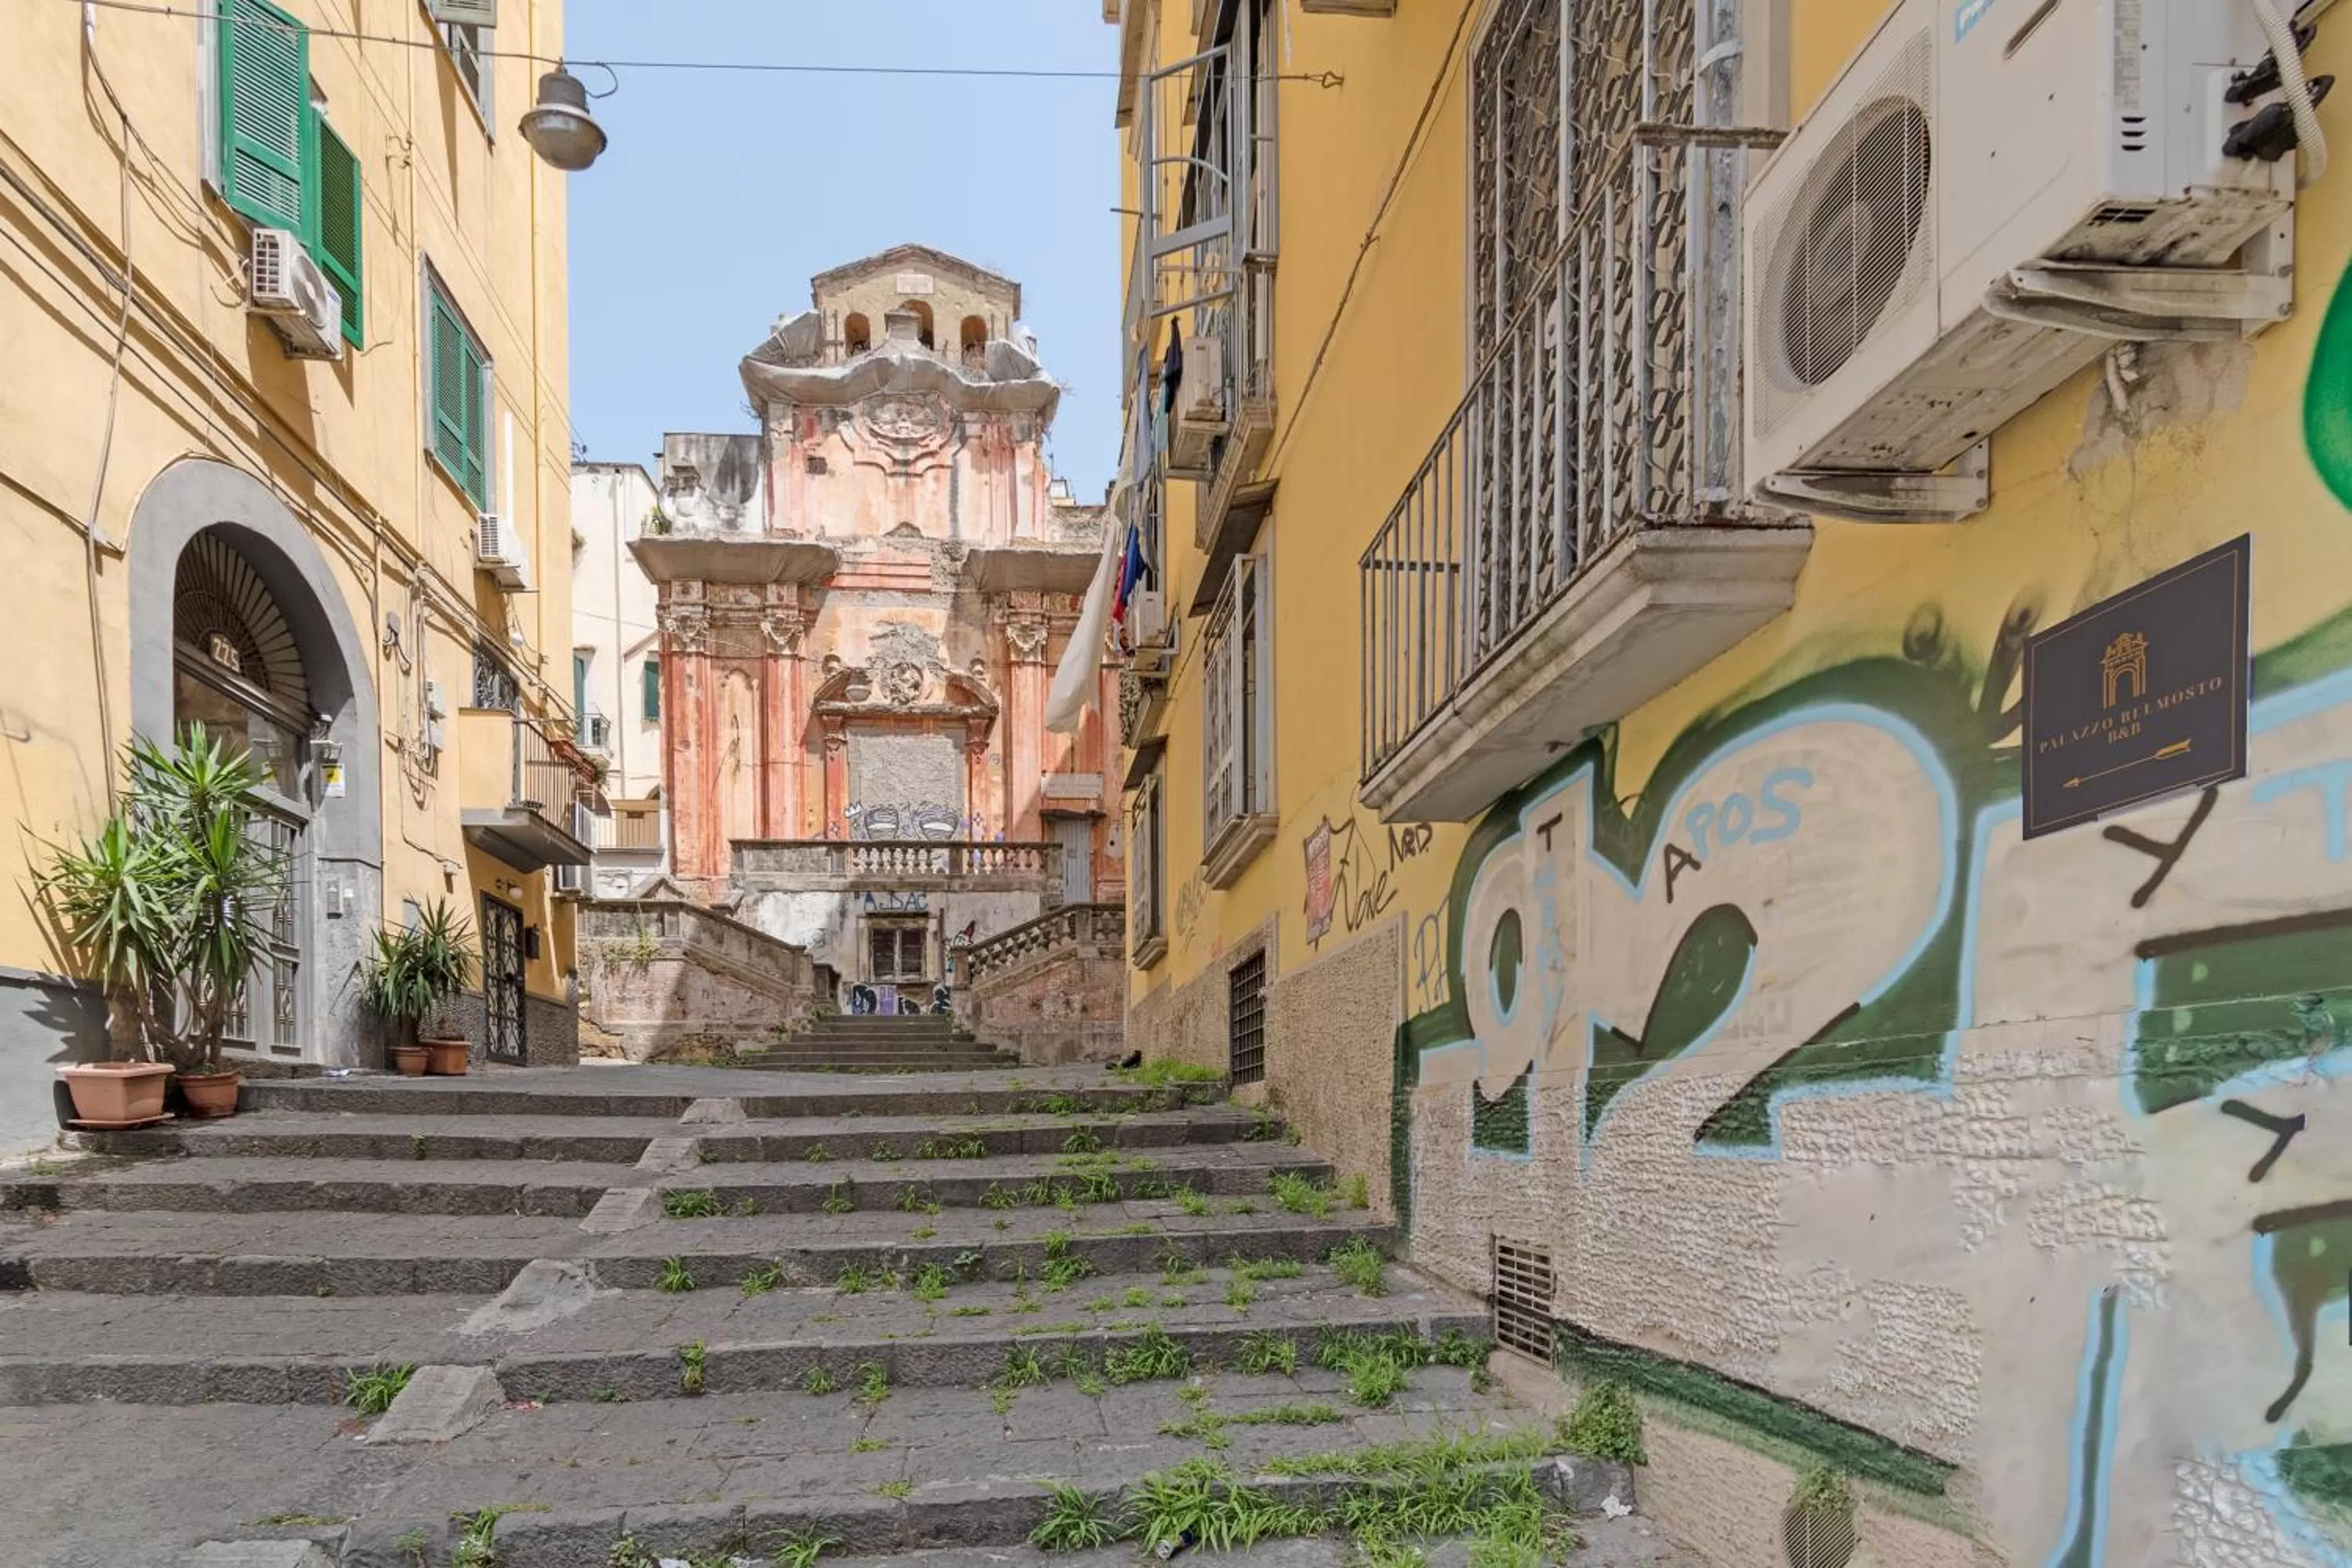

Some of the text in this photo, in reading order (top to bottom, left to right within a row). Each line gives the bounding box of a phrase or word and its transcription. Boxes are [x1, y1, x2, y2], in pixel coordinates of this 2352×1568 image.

[212, 637, 240, 673] 225
[2038, 717, 2114, 753] PALAZZO
[2107, 721, 2142, 745] B&B
